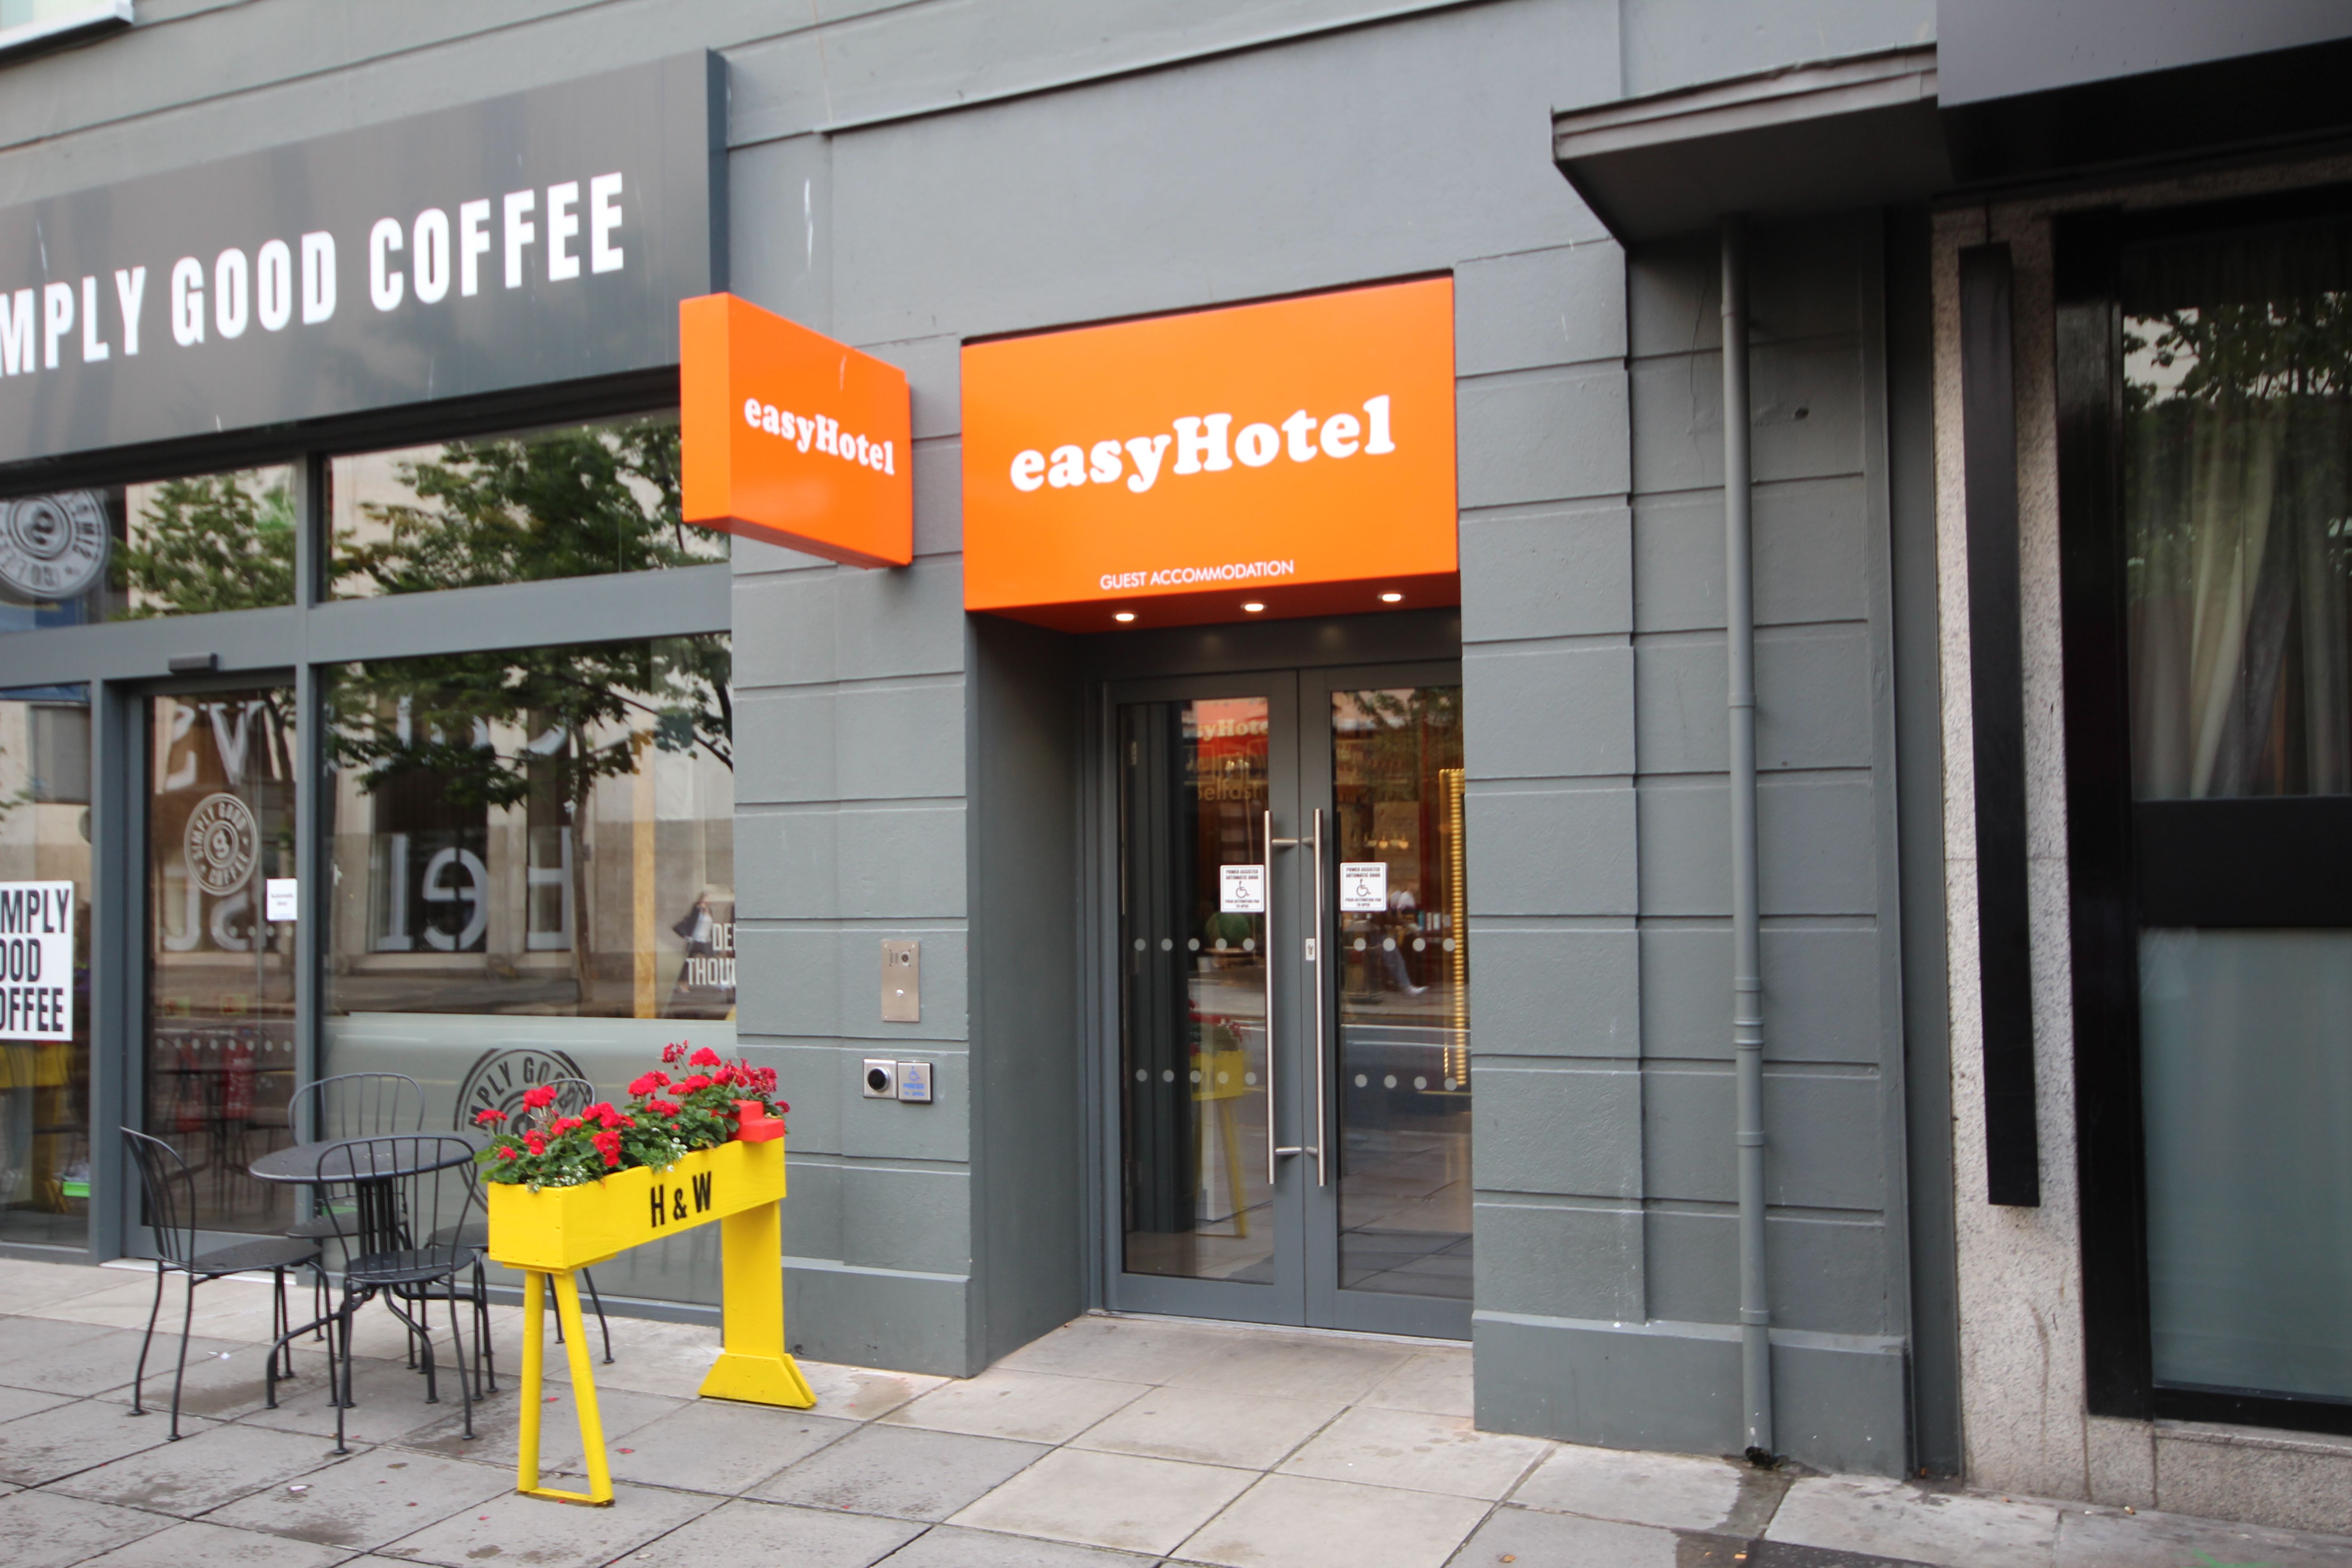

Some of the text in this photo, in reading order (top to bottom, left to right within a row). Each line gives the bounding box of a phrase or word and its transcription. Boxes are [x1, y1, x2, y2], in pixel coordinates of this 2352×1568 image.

[0, 172, 624, 378] MPLY GOOD COFFEE
[744, 397, 895, 475] easyHotel
[1010, 395, 1396, 493] easyHotel
[1100, 559, 1294, 590] GUEST ACCOMMODATION
[0, 888, 69, 934] MPLY
[712, 923, 736, 951] DE
